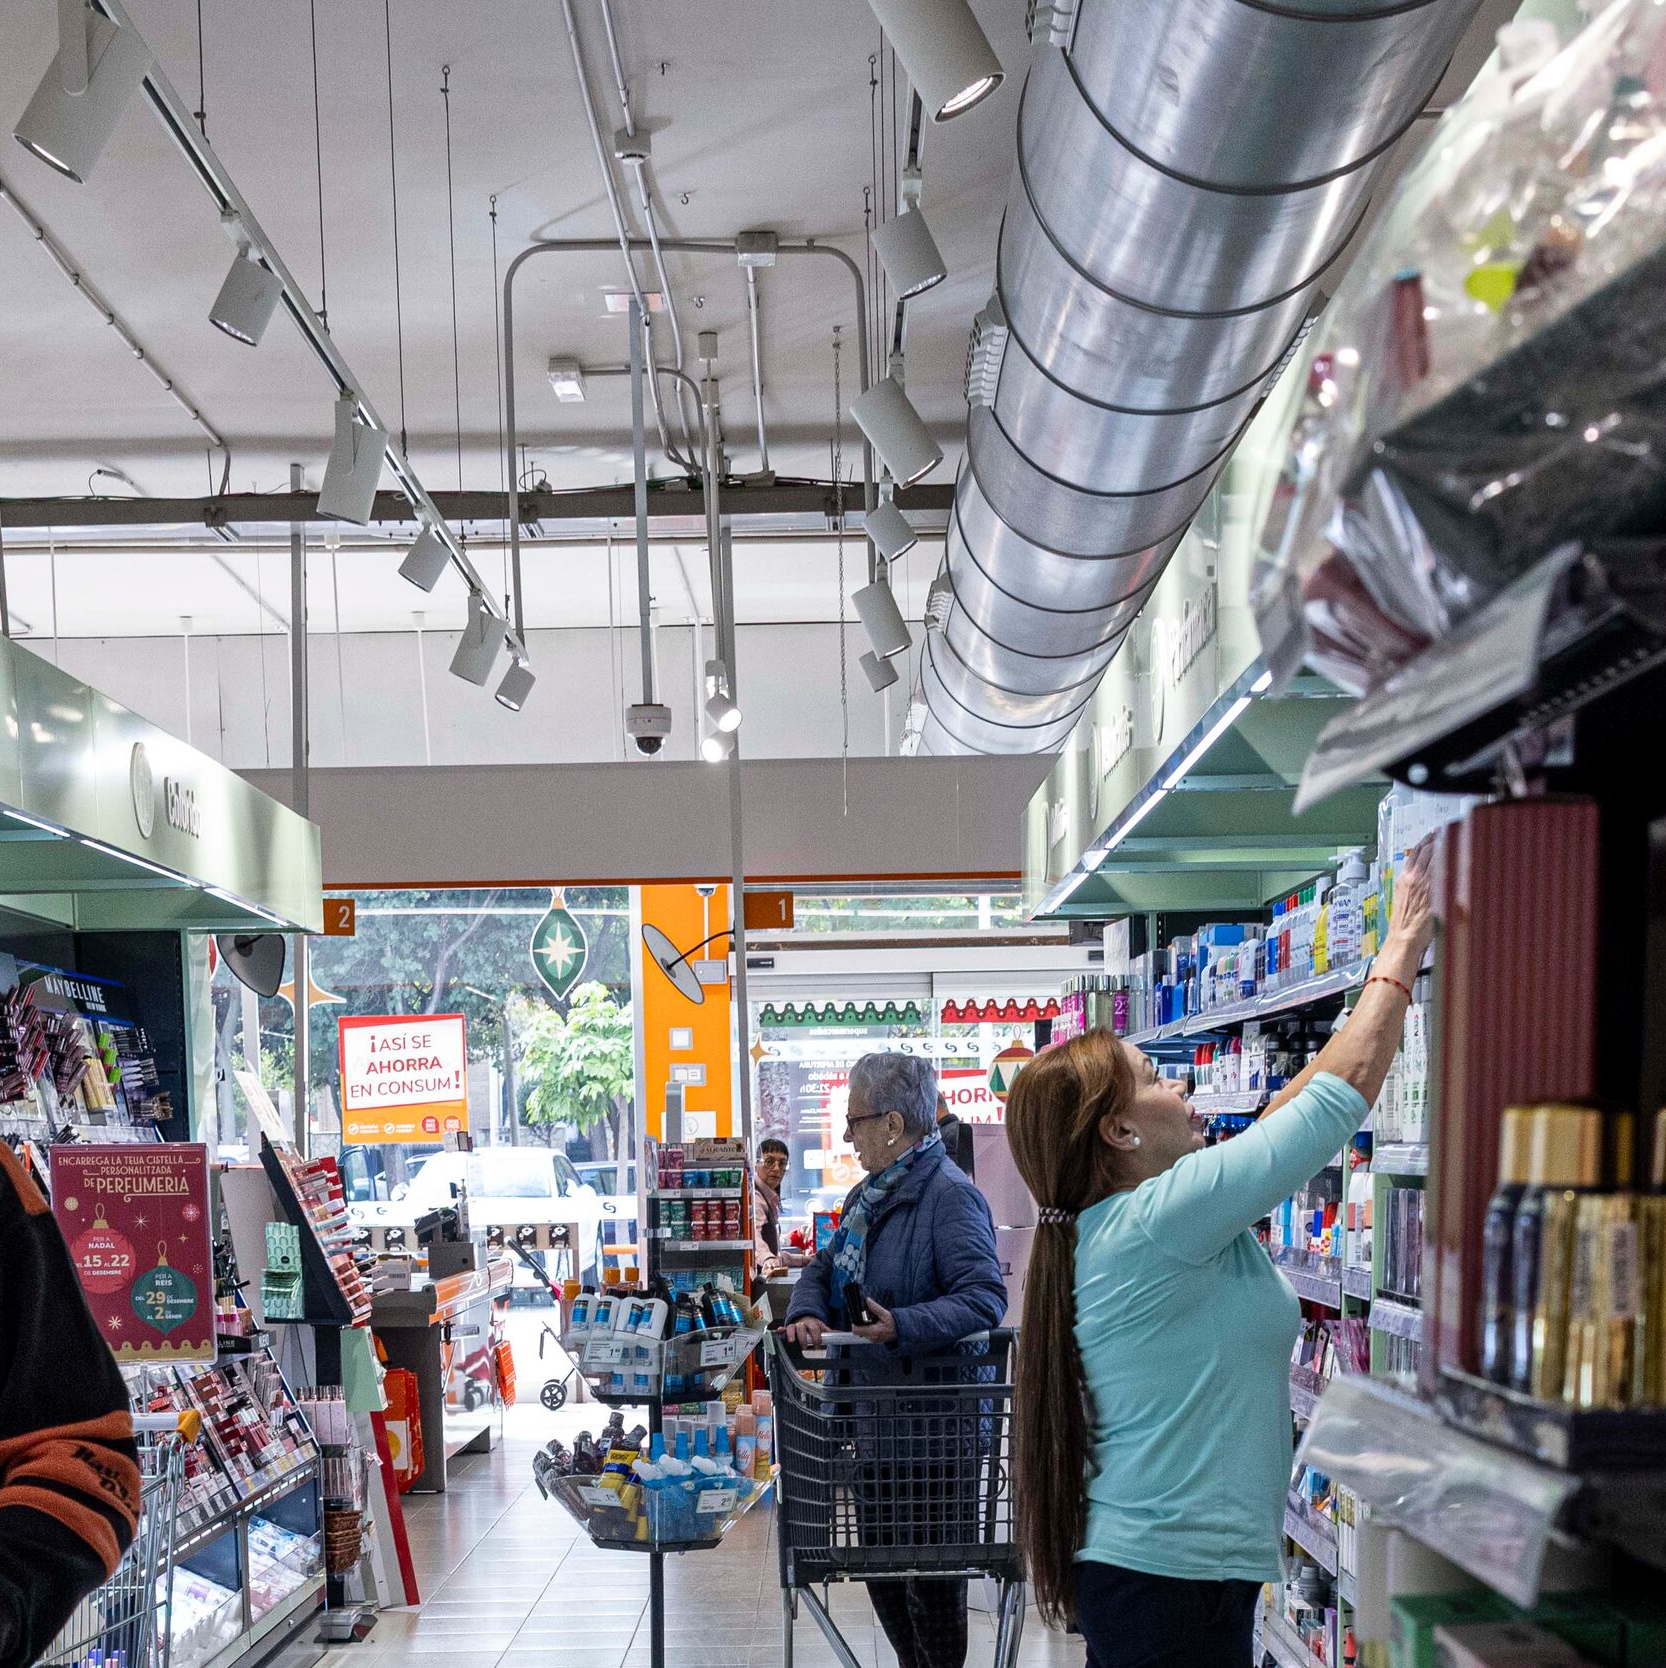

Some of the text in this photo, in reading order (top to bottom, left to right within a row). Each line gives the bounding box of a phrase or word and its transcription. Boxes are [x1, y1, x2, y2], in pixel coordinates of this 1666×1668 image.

[338, 905, 350, 929] 2
[777, 898, 787, 922] 1
[44, 976, 106, 1004] MAYBELLINE
[411, 1034, 432, 1051] SE
[366, 1056, 442, 1075] AHORRA
[350, 1083, 372, 1098] EN
[58, 1155, 184, 1167] ENCARREGA LA TEUA CISTELLA
[100, 1165, 172, 1175] PERSONALITZADA
[84, 1177, 190, 1193] DE PERFUMERIA
[83, 1254, 102, 1268] 15
[110, 1254, 130, 1267] 22
[146, 1291, 166, 1304] 29
[155, 1306, 164, 1319] 2
